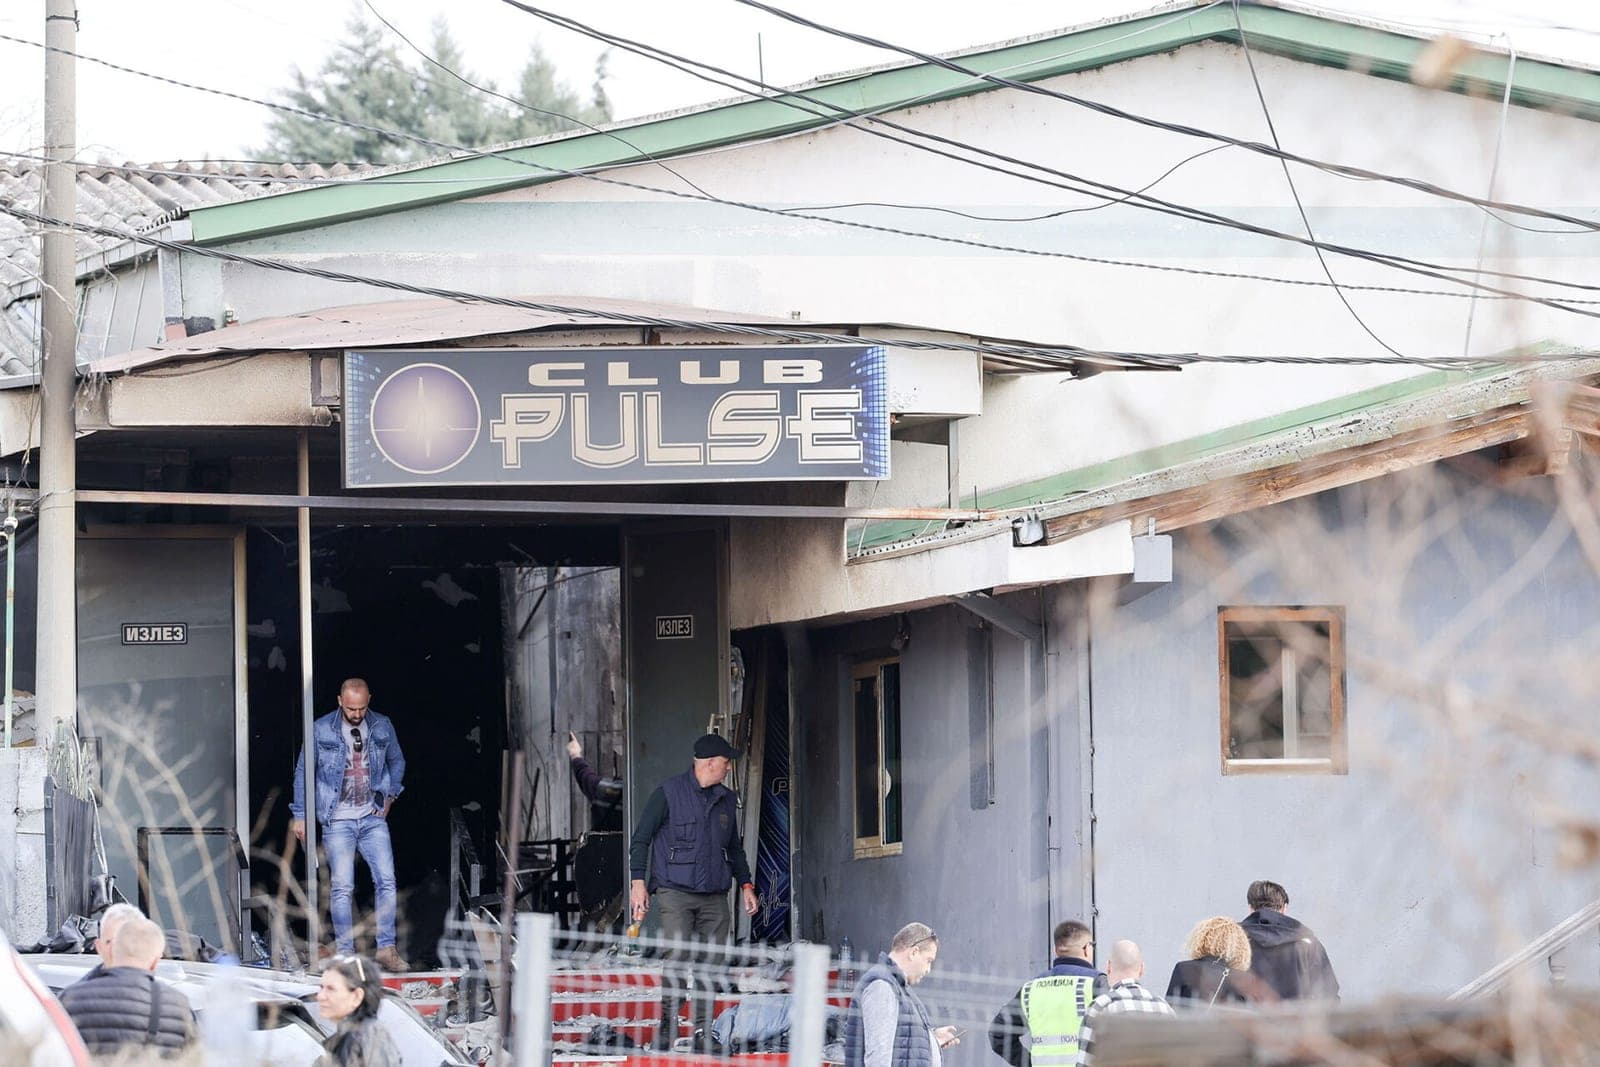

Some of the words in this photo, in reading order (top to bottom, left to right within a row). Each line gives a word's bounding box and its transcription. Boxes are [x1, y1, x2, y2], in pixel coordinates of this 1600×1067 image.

[528, 360, 824, 385] CLUB
[490, 390, 863, 468] PULSE
[126, 627, 184, 641] ИЗЛЕЗ
[658, 619, 690, 635] ИЗЛЕЗ
